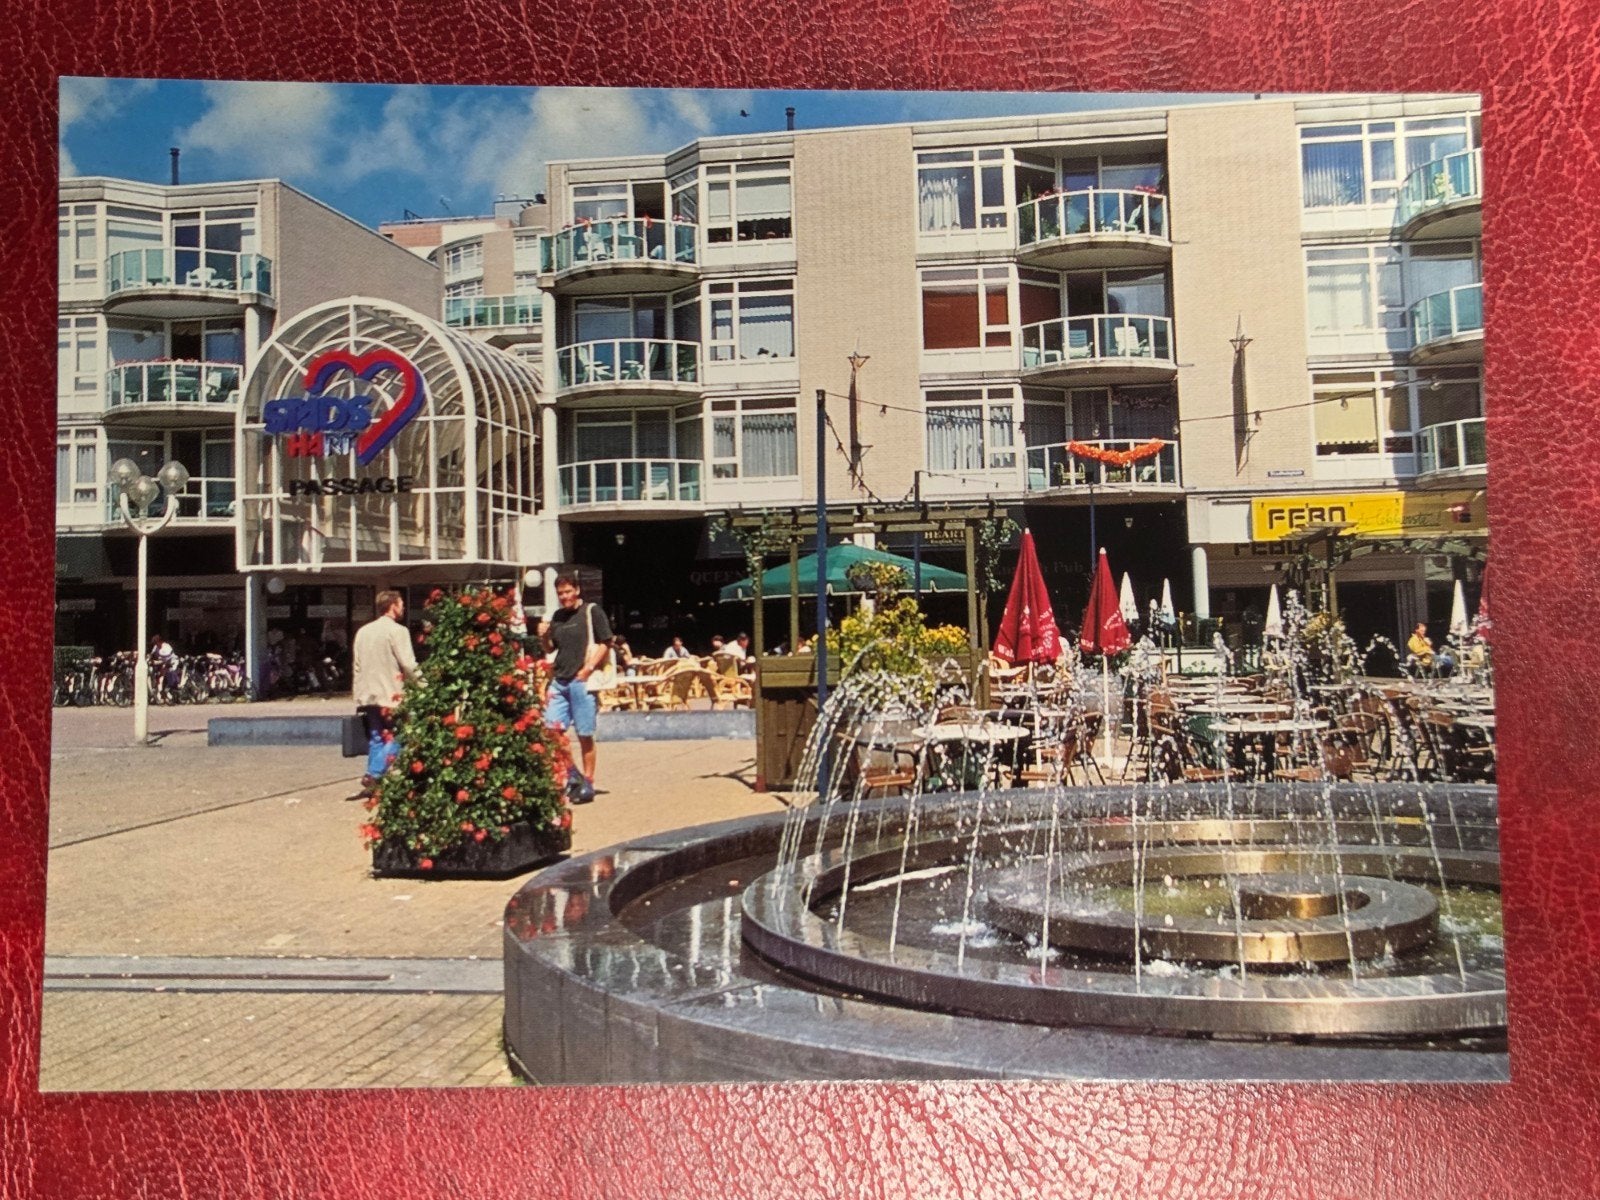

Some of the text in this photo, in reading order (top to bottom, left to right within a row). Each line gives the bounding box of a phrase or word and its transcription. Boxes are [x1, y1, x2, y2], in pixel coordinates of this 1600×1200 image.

[263, 395, 374, 434] STADS
[287, 431, 359, 458] HART
[288, 475, 414, 497] PASSAGE
[1268, 506, 1346, 530] FEBO
